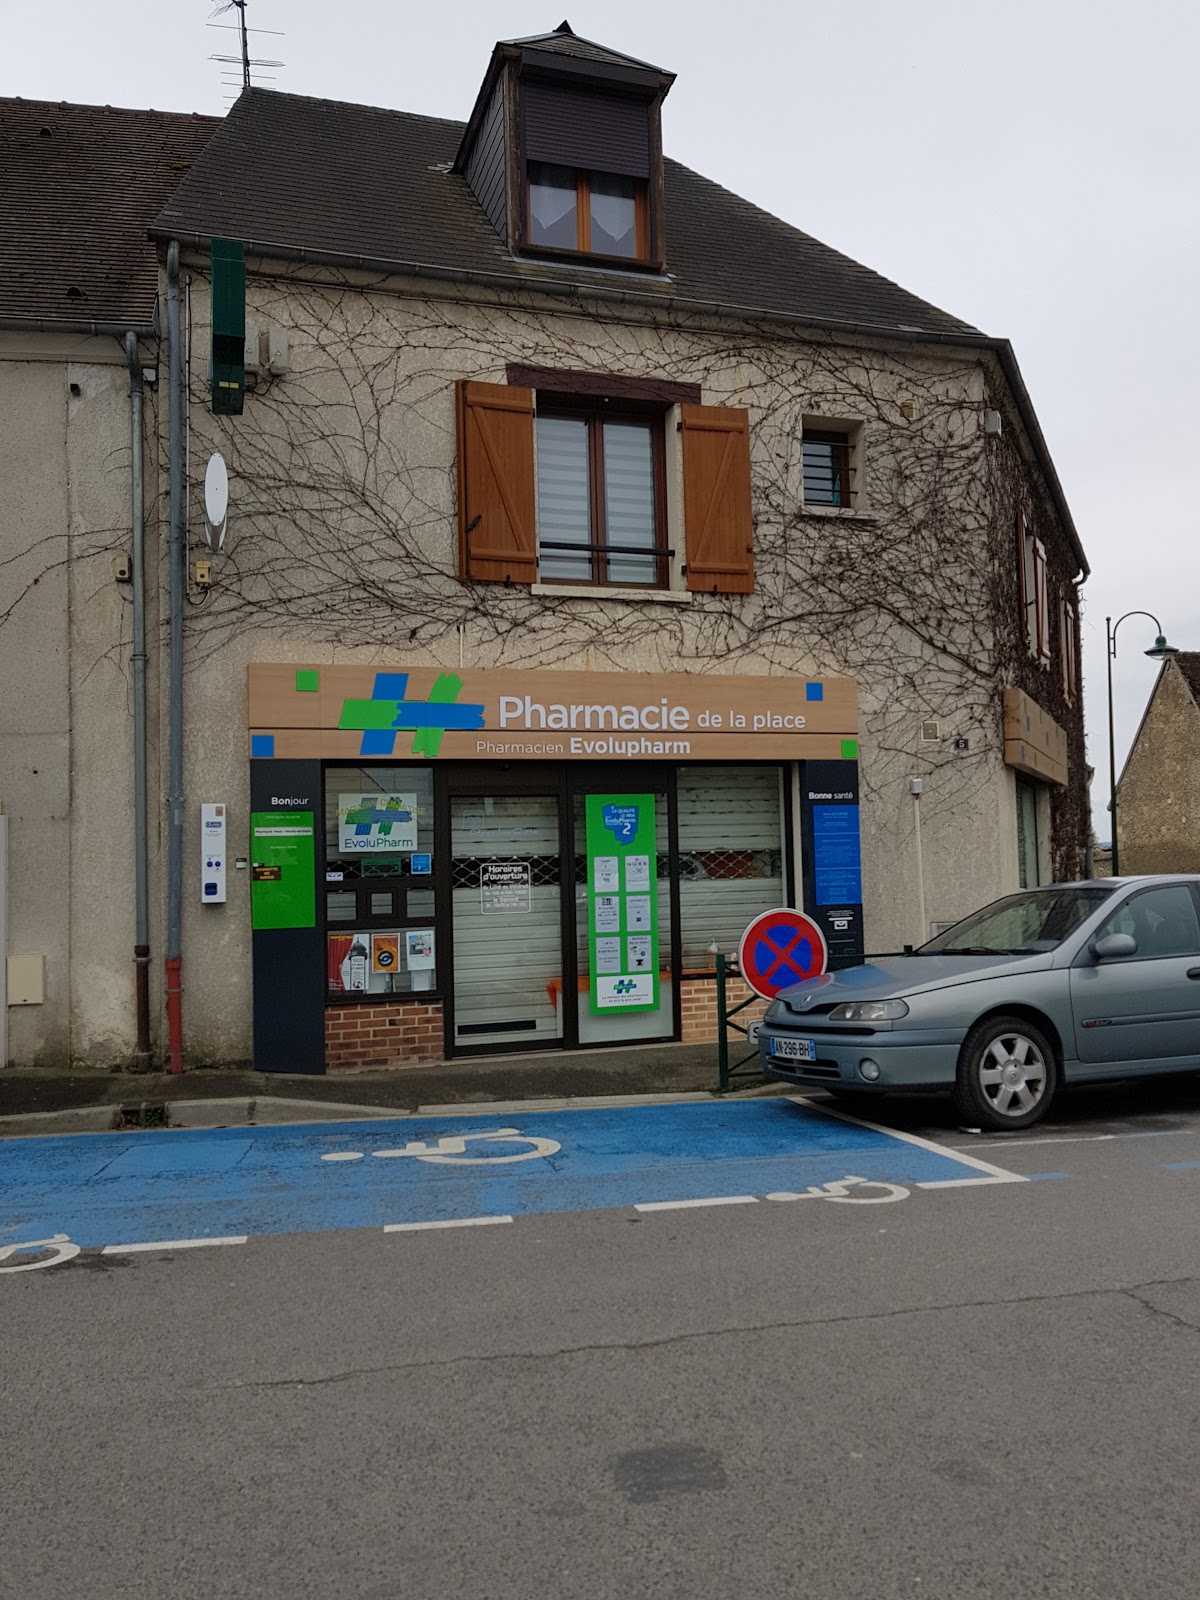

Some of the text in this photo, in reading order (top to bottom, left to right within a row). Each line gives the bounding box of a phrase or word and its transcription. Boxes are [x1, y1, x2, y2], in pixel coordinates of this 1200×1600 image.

[499, 695, 806, 731] Pharmacie de la place
[476, 736, 691, 757] Pharmacien Evolupharm
[958, 740, 965, 748] 5
[808, 791, 853, 800] Bonne santé
[271, 796, 309, 806] Bonjour
[622, 822, 631, 835] 2
[344, 838, 413, 848] EvoluPharm
[489, 865, 523, 873] Horaires
[483, 872, 528, 881] d'ouverture
